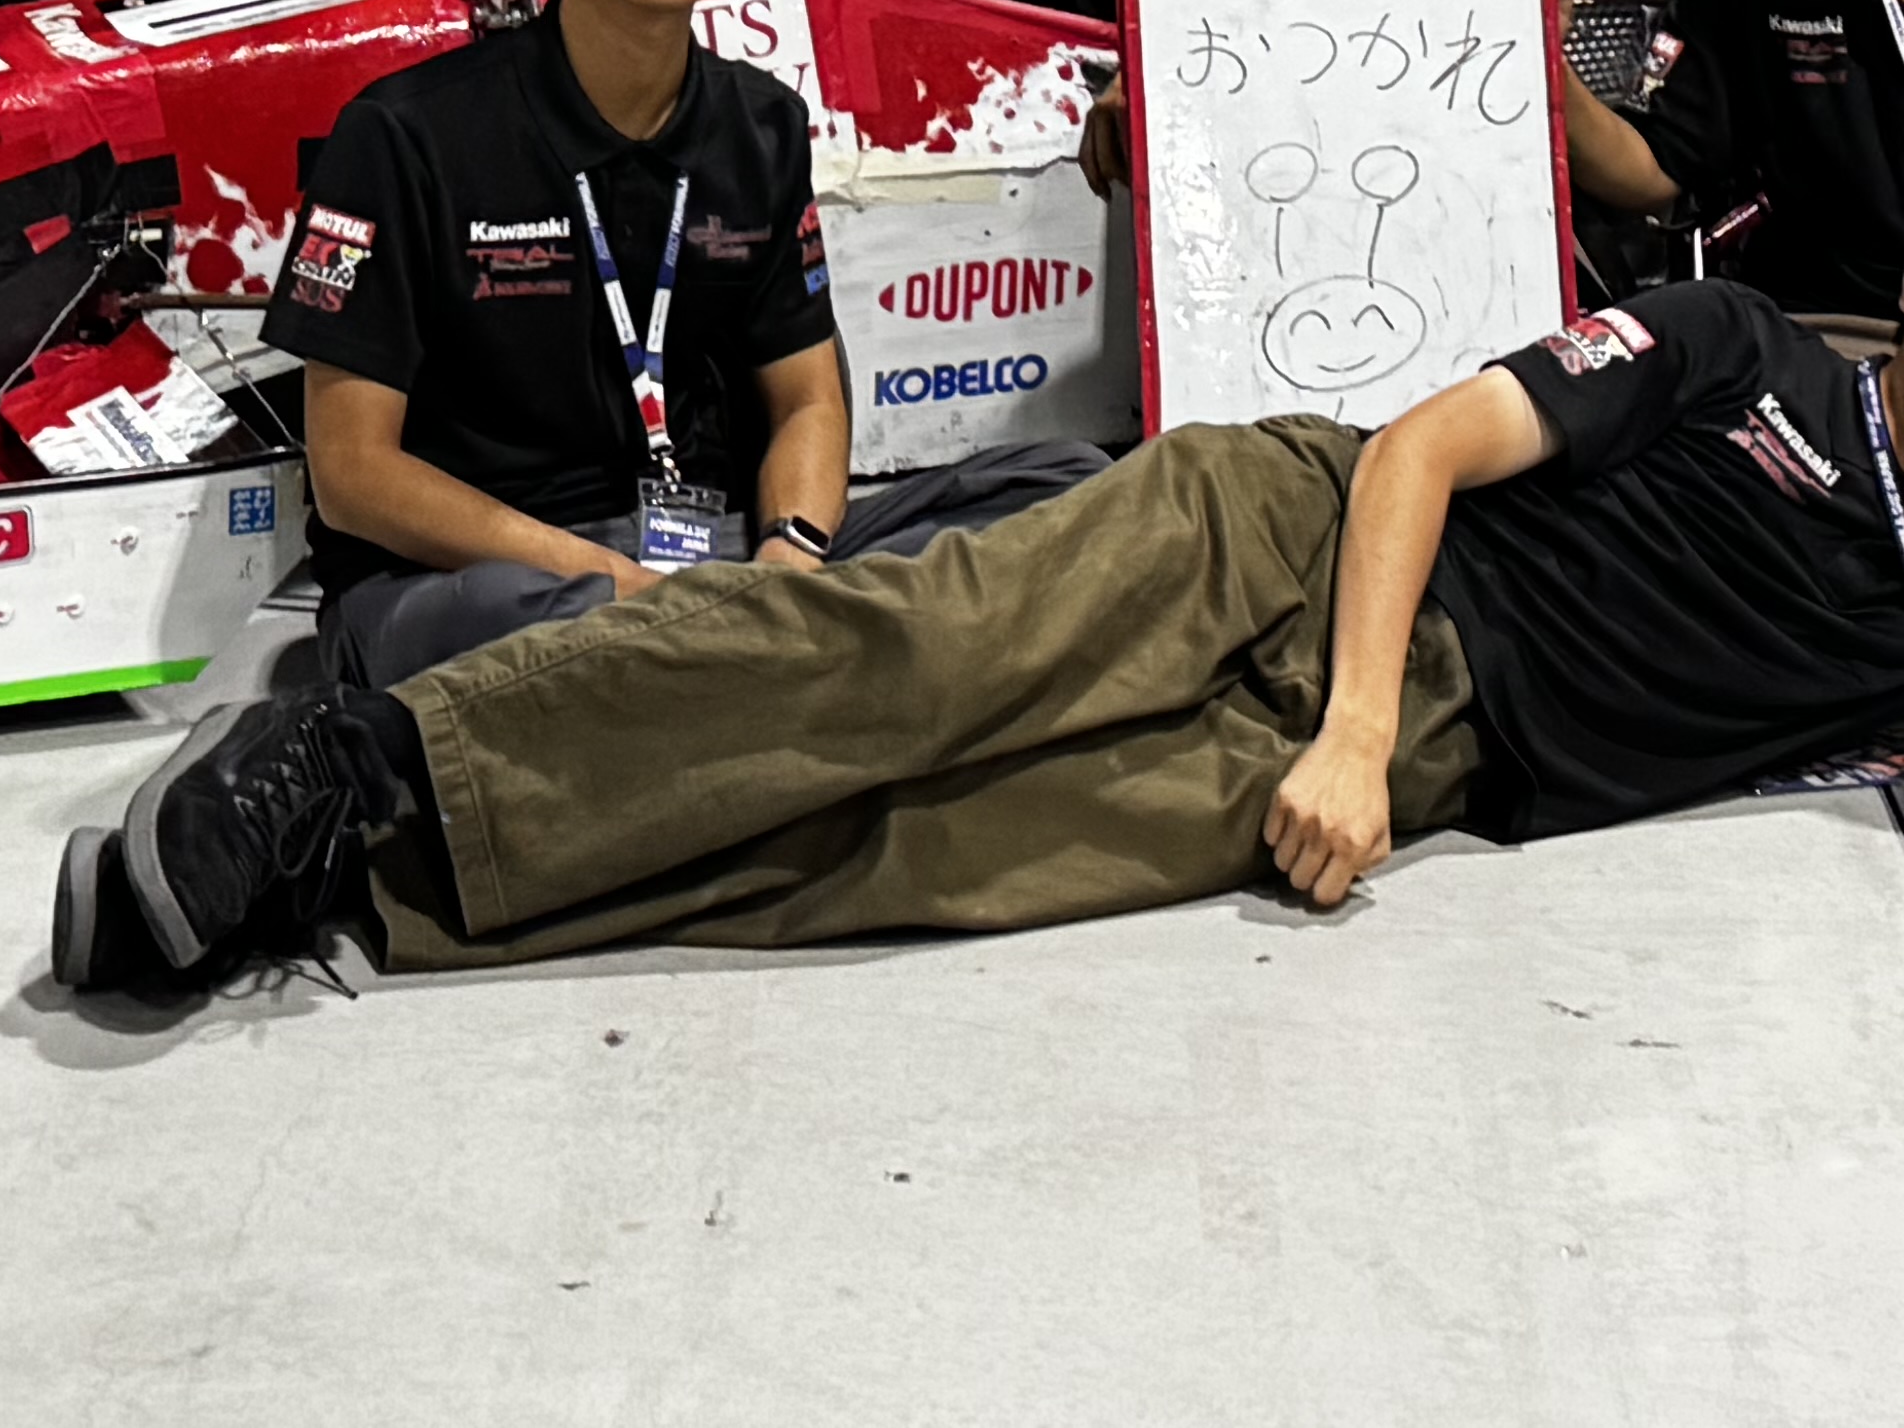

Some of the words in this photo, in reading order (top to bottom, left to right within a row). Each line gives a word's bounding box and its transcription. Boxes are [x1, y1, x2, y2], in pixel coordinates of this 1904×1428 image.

[1768, 14, 1844, 34] Kawasaki
[1177, 9, 1530, 125] おつかれ
[309, 207, 368, 243] MOTUL
[470, 216, 571, 242] Kawasaki
[905, 257, 1070, 322] DUPONT
[874, 353, 1048, 406] KOBELCO
[1756, 392, 1842, 489] Kawasaki
